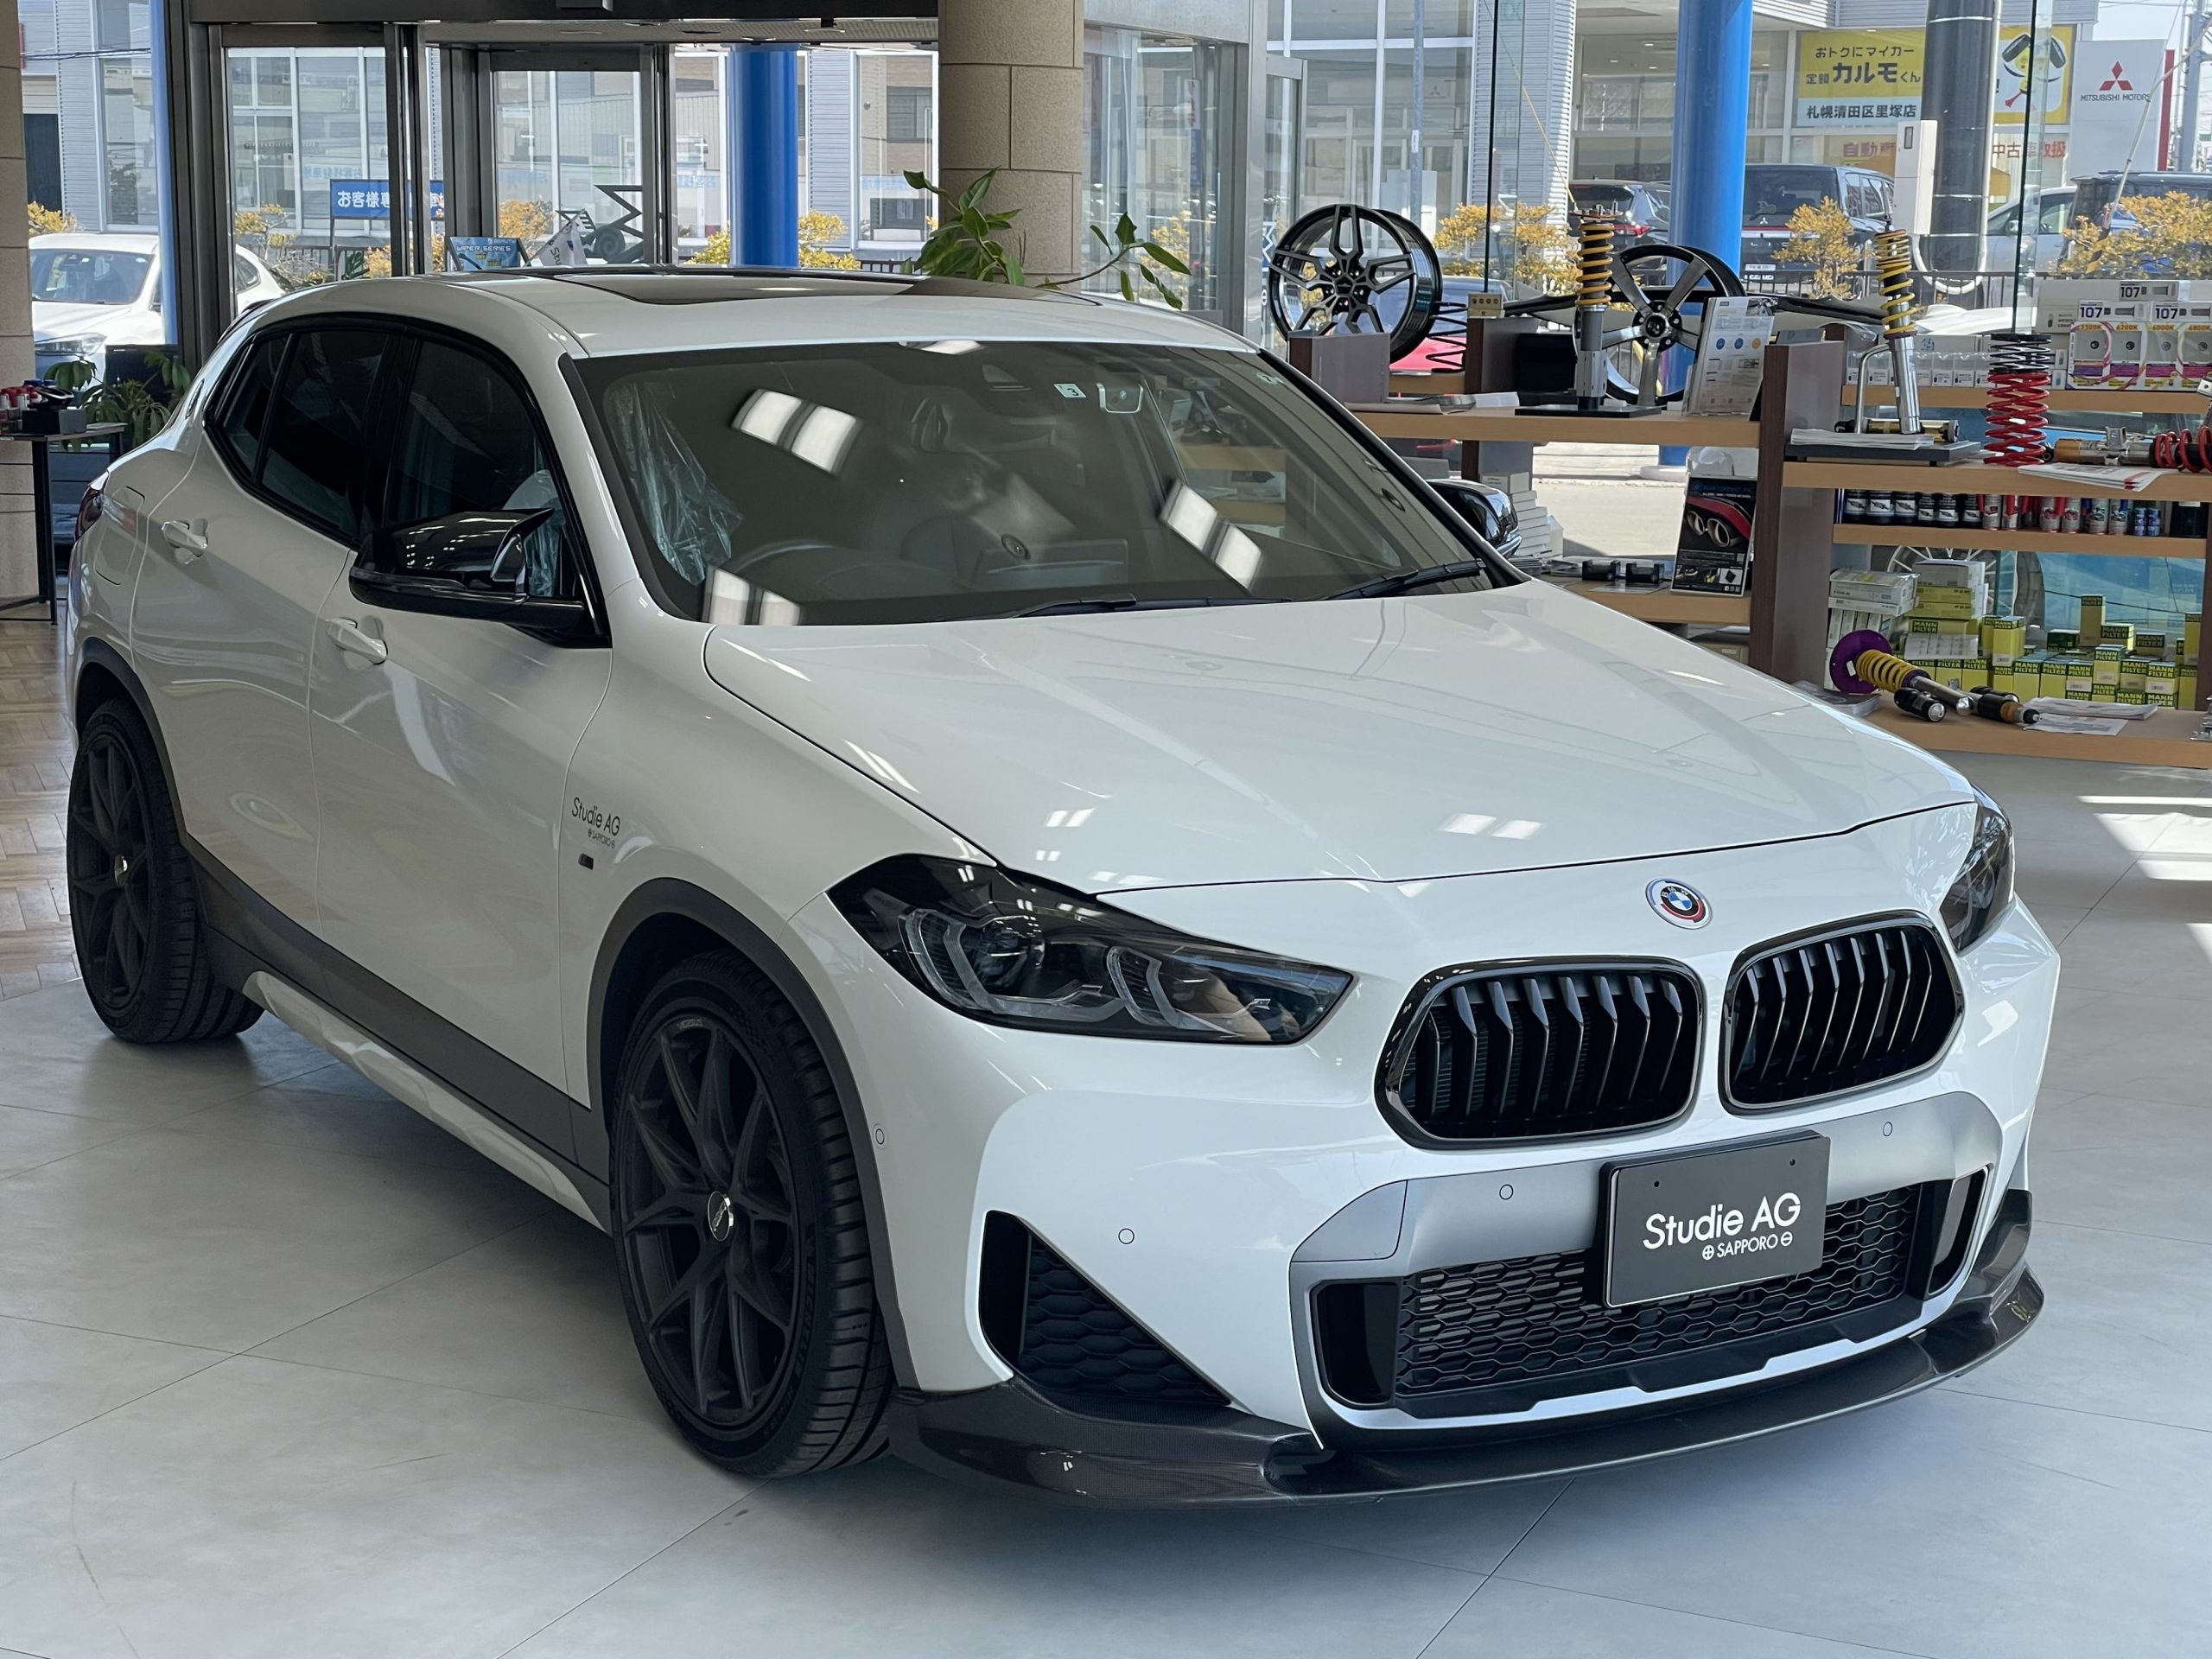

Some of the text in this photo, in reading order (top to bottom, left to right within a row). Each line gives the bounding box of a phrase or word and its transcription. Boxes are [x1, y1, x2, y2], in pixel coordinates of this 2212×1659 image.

[1815, 46, 1915, 59] おトクにマイカー
[1807, 104, 1917, 119] 札幌清田区里塚店
[2120, 286, 2140, 298] 107
[2081, 307, 2102, 318] 107
[2155, 308, 2178, 319] 107
[572, 797, 620, 836] Studie AG
[1643, 1192, 1802, 1249] Studie AG
[1717, 1234, 1778, 1258] SAPPORO
